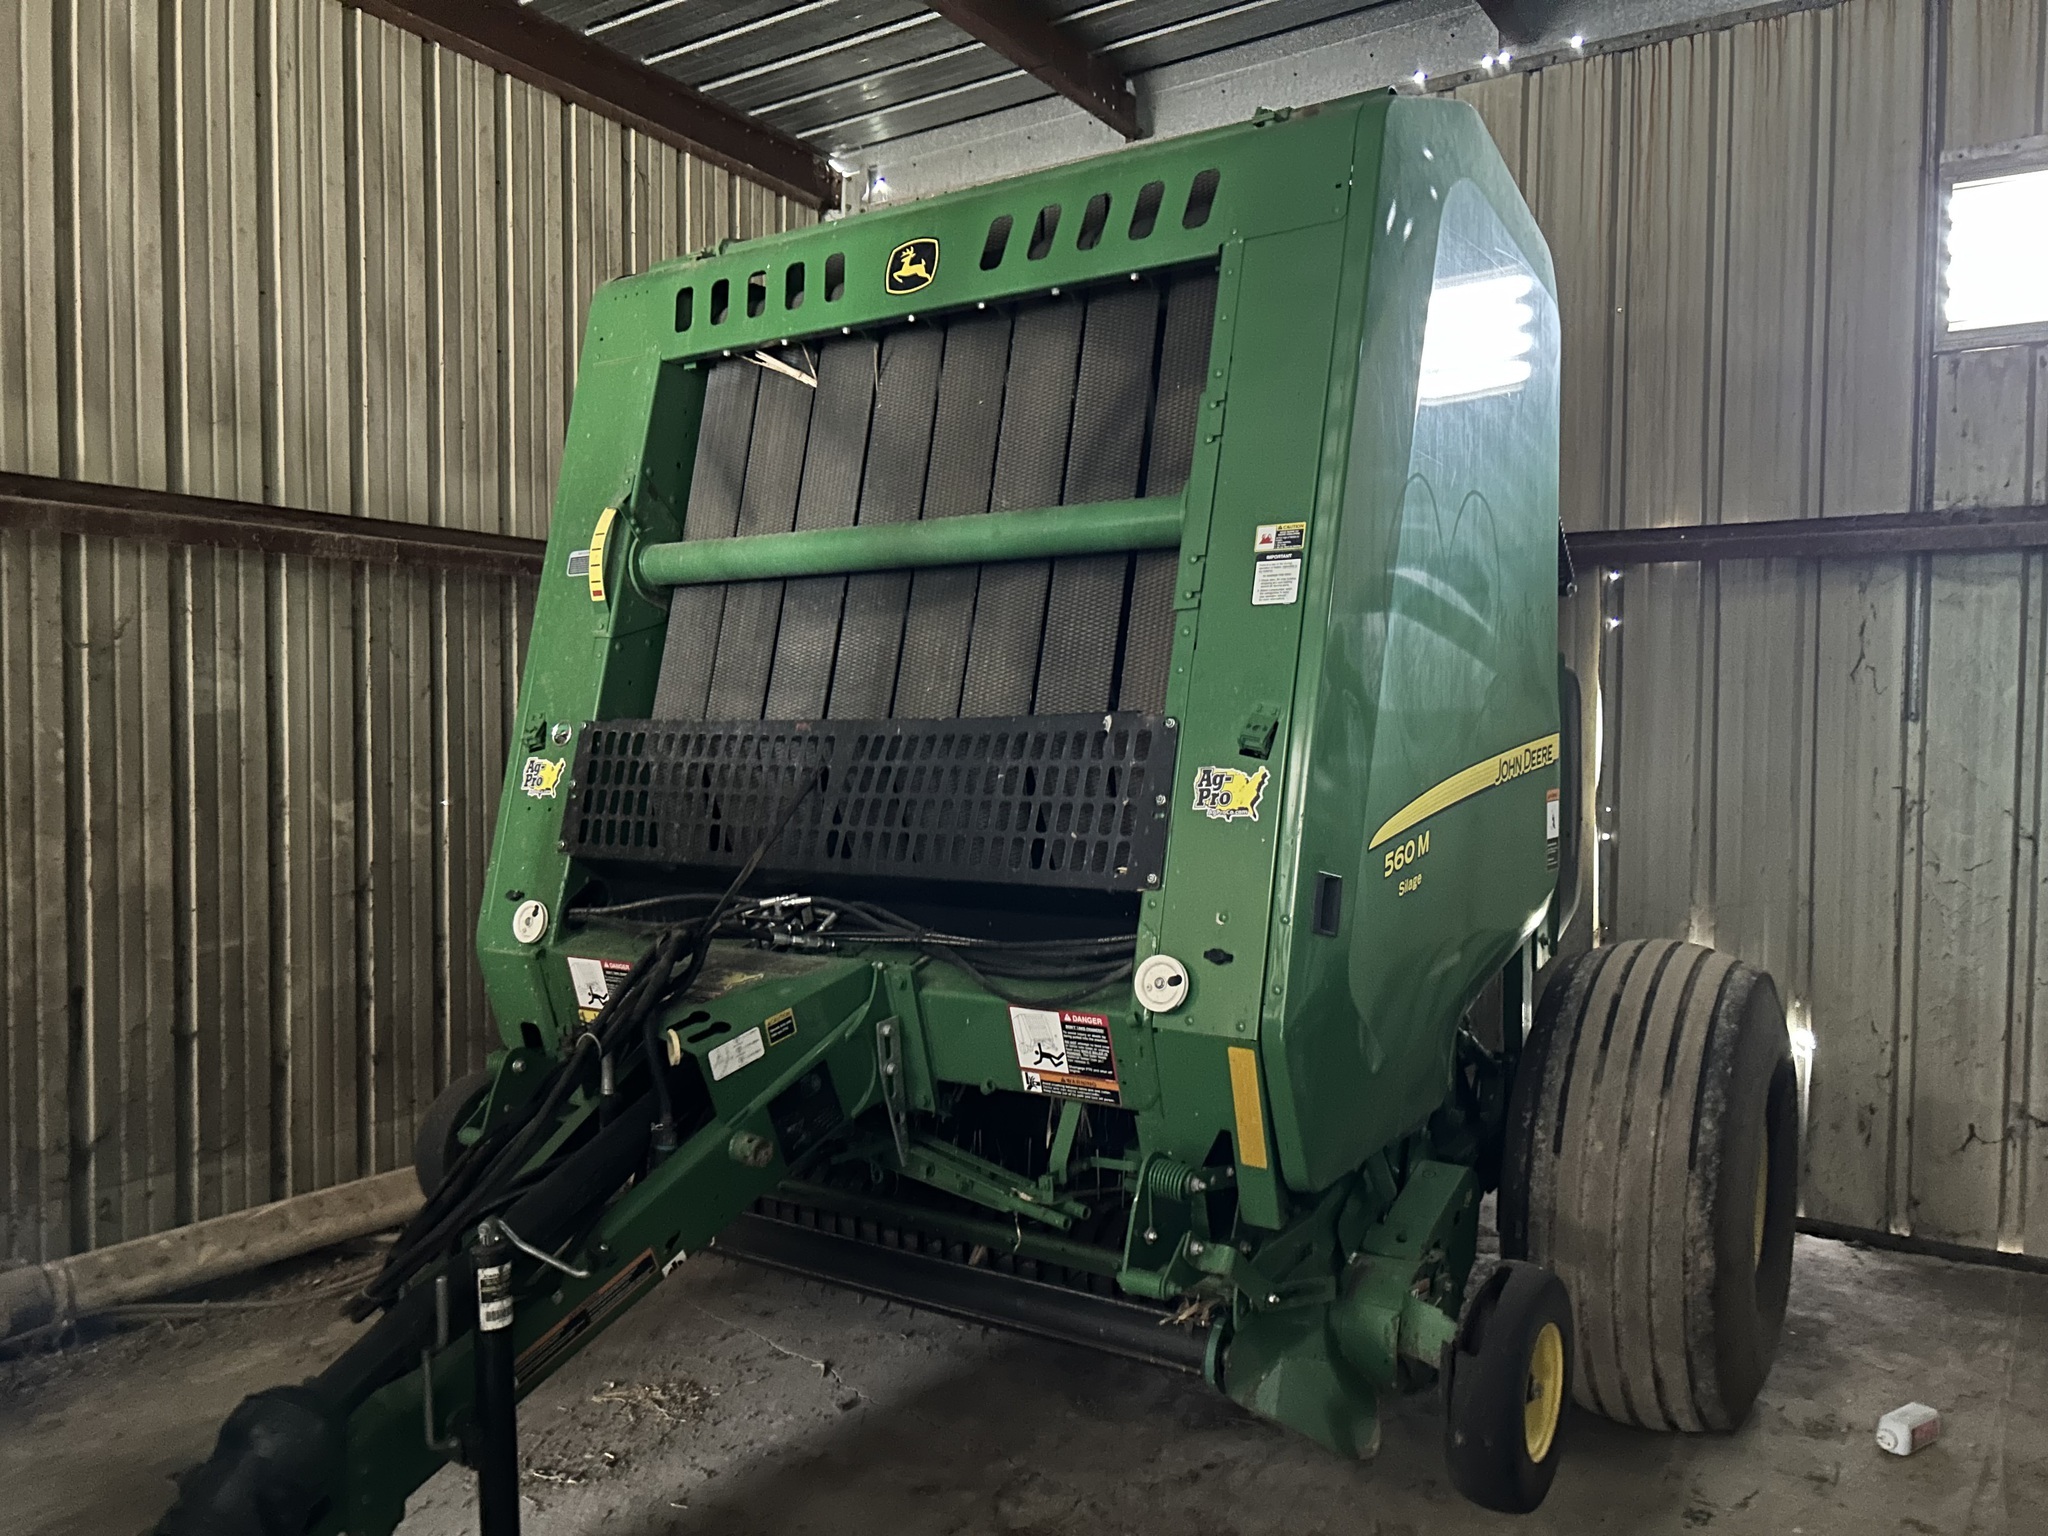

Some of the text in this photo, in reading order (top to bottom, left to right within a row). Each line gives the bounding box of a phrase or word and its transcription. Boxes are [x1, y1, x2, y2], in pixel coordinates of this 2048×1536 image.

[1495, 744, 1553, 783] JOHN DEERE
[524, 773, 543, 787] Pro
[1198, 769, 1232, 791] Ag-
[1196, 788, 1231, 806] Pro
[1384, 829, 1430, 878] 560 M
[1398, 873, 1423, 897] Silage
[609, 962, 631, 971] DANGER
[1072, 1015, 1103, 1025] DANGER
[1065, 1078, 1097, 1088] WARNING
